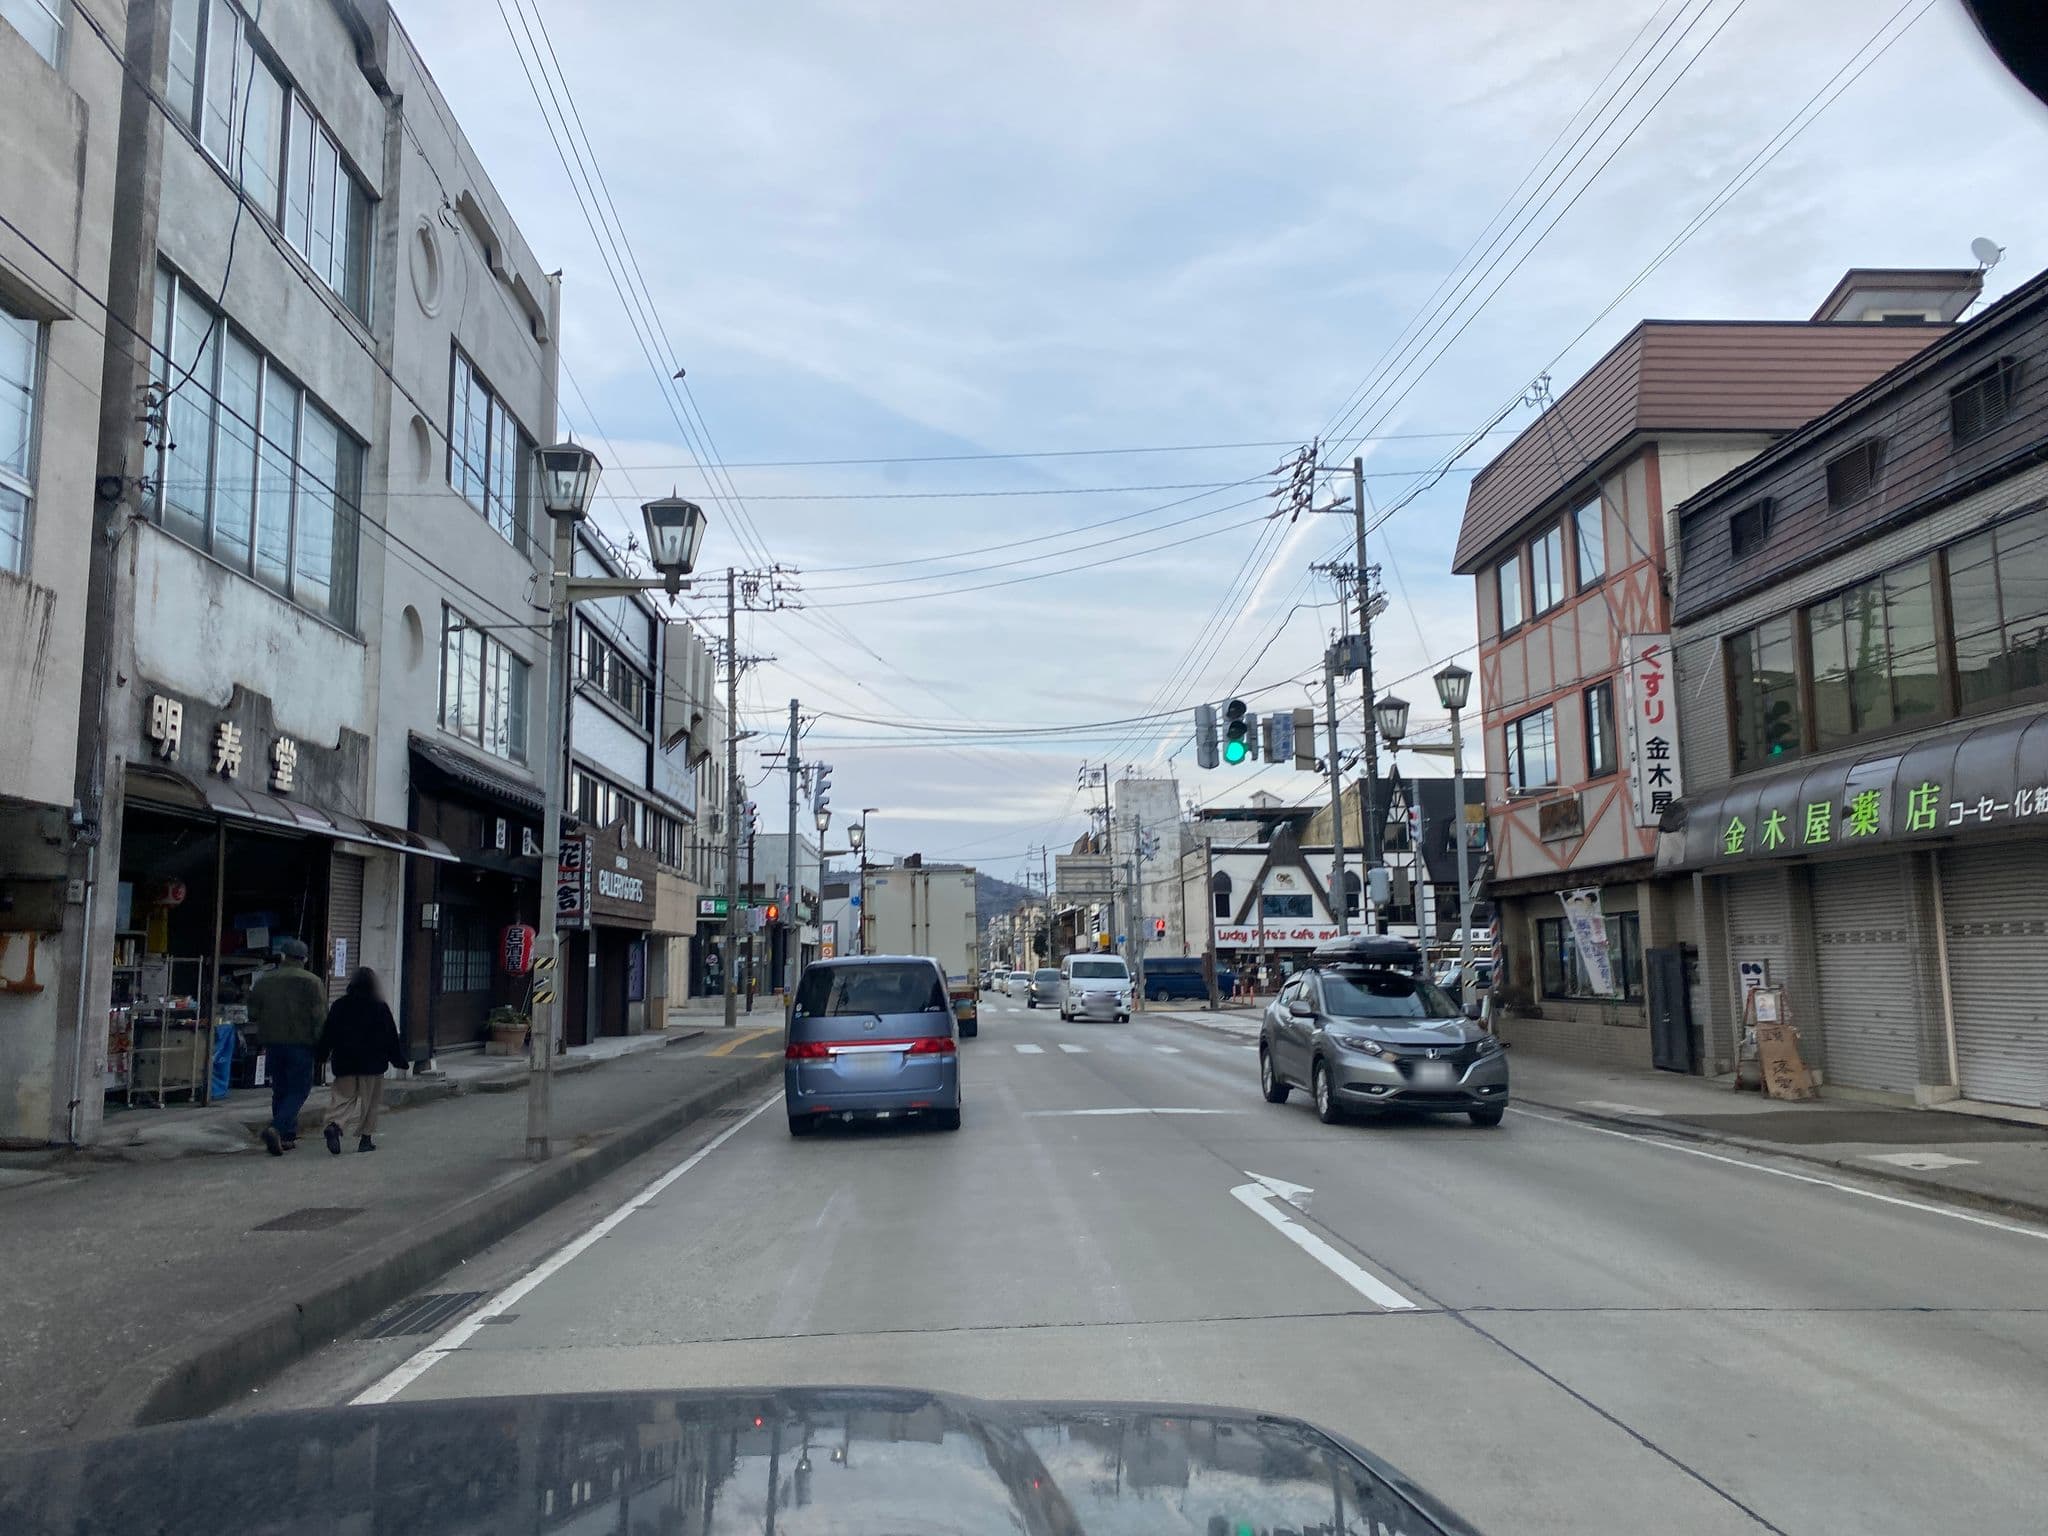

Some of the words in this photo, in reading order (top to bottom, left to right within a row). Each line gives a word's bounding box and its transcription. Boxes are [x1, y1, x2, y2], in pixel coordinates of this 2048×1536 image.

[1640, 644, 1664, 724] くすり
[151, 694, 297, 793] 明寿堂
[1646, 736, 1673, 814] 金木屋
[1722, 782, 1940, 855] 金木屋薬店
[506, 927, 523, 971] 居酒屋
[1218, 930, 1247, 943] Lucky
[1252, 929, 1286, 941] Pte's
[1291, 929, 1315, 940] Cafe
[1318, 929, 1338, 940] and
